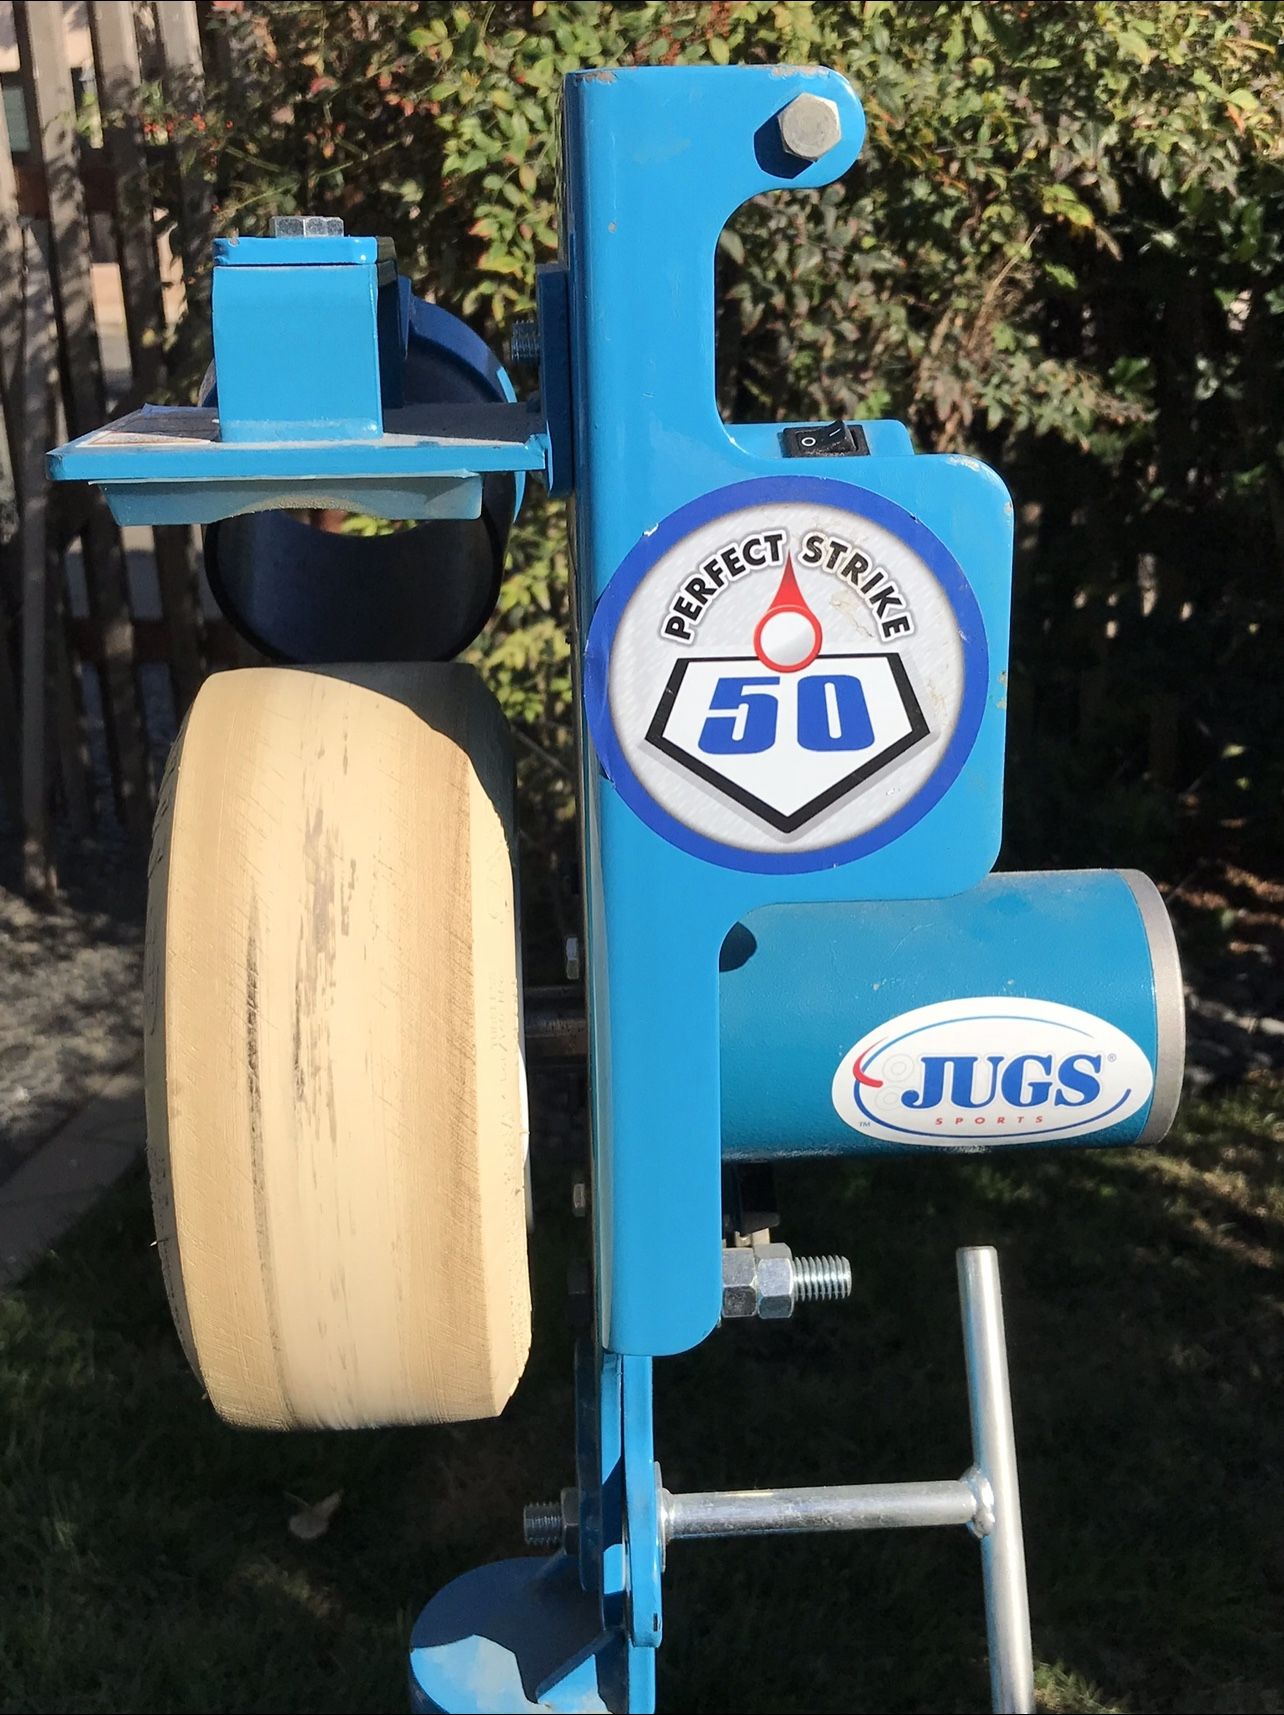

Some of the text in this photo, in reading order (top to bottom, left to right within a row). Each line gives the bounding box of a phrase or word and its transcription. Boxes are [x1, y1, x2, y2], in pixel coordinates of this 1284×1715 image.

[665, 533, 911, 640] PERFECT STRIKE
[698, 674, 875, 755] 50
[936, 1116, 1044, 1125] SPORTS
